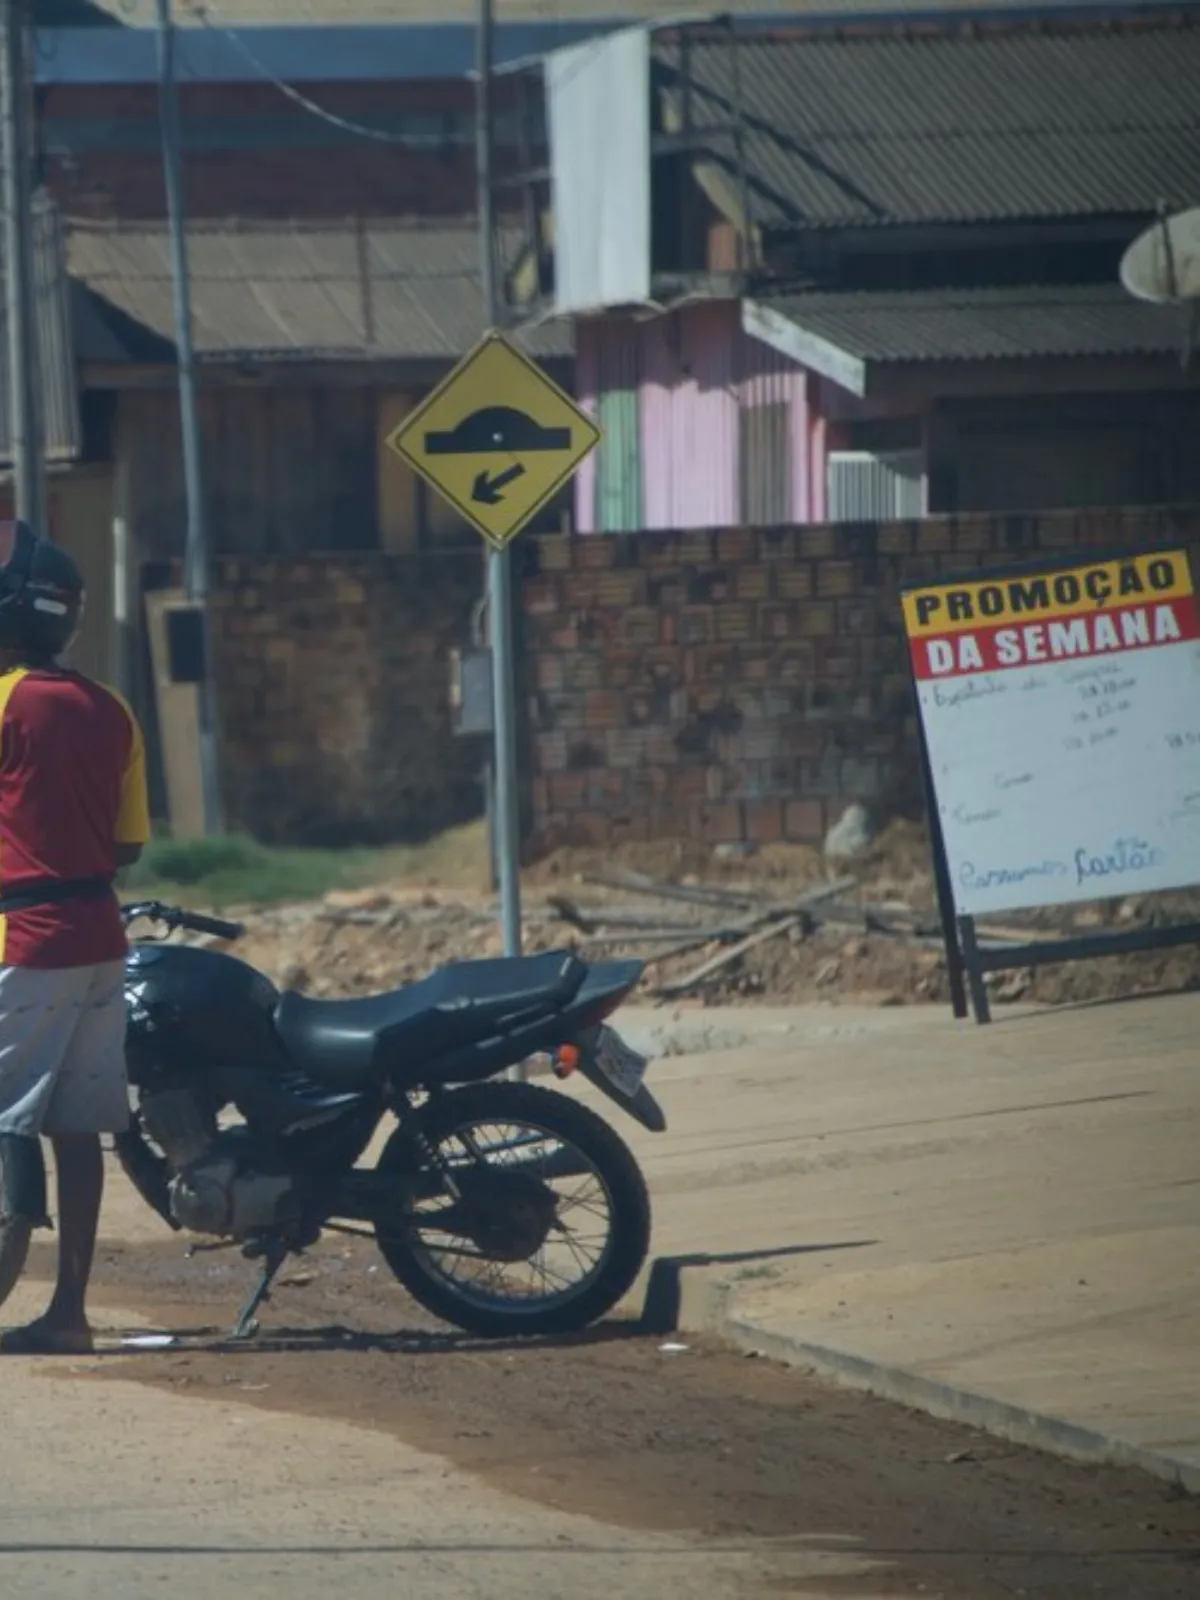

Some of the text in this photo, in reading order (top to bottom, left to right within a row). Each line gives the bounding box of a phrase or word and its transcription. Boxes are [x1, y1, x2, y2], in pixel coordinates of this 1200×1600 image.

[915, 557, 1176, 627] PROMOÇÃO
[926, 603, 1182, 675] DA SEMANA
